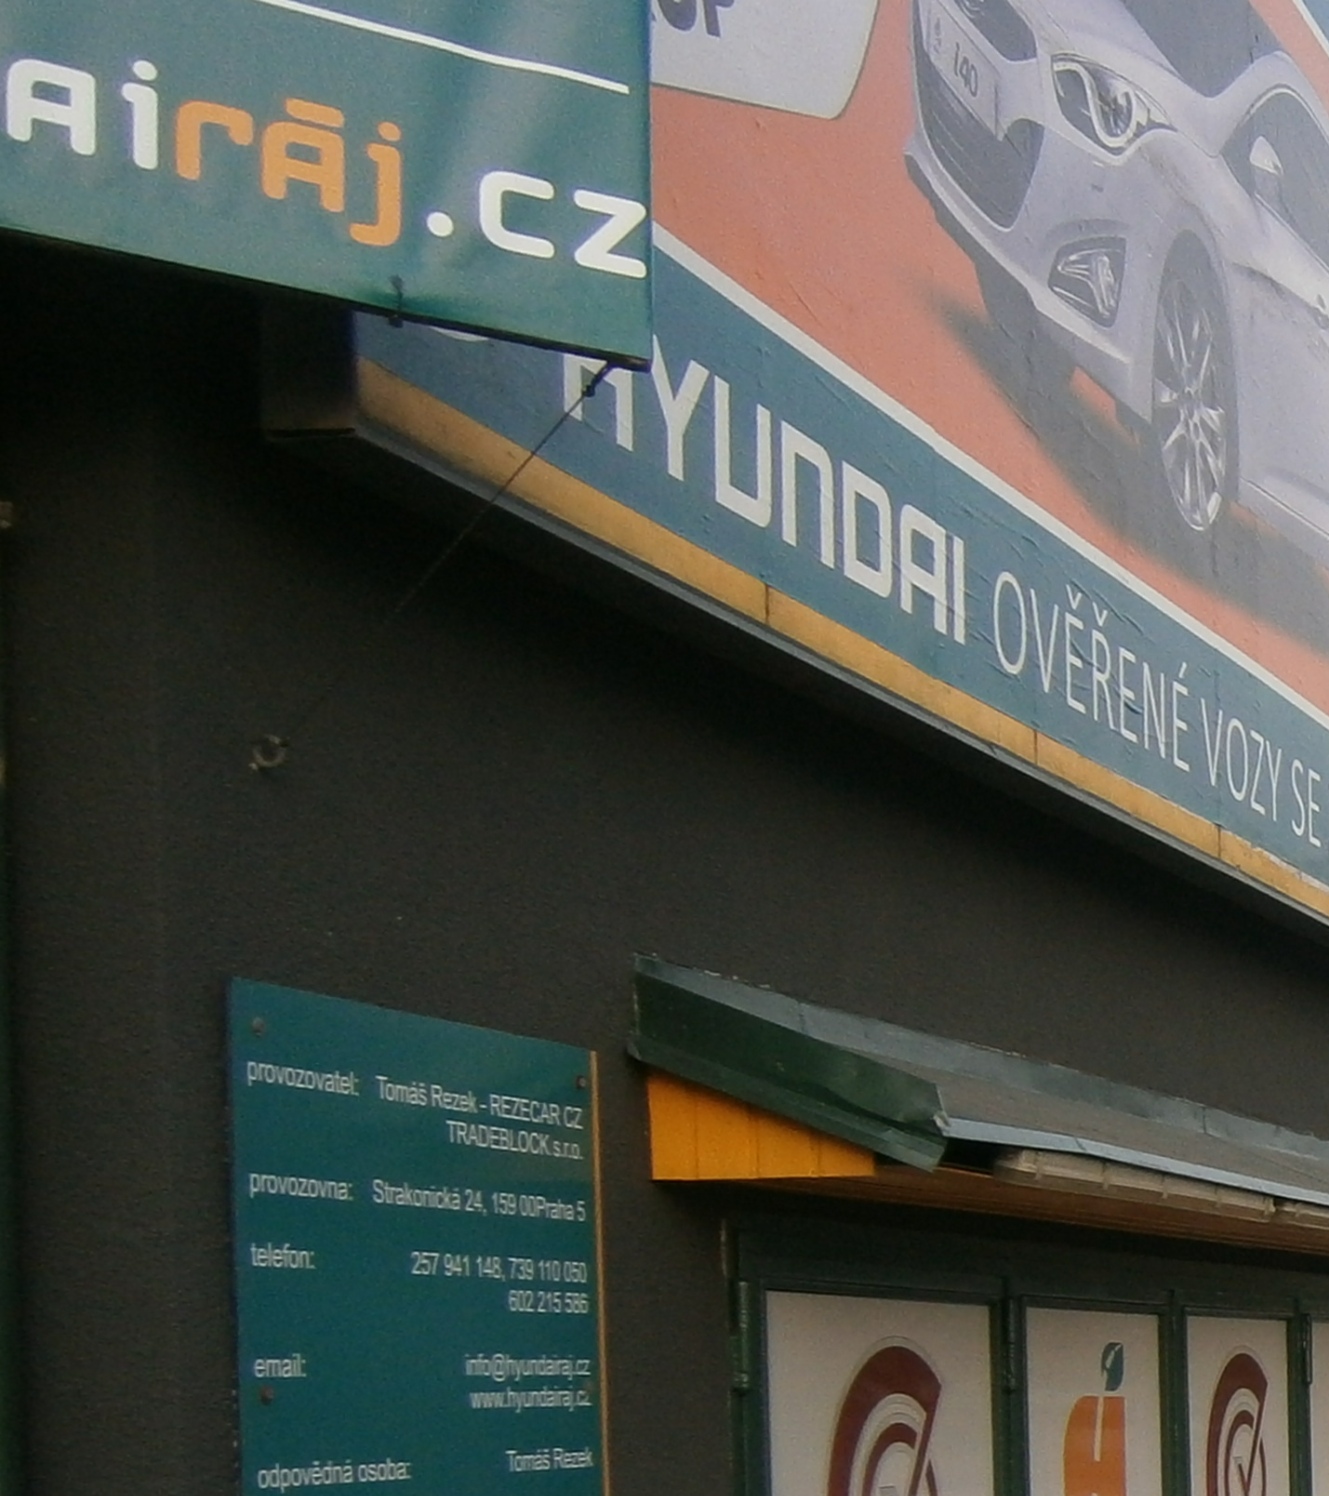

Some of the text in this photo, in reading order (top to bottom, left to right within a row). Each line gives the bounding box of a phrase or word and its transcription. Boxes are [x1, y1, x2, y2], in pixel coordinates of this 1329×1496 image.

[992, 570, 1190, 773] OVĚŘENÉ
[1200, 696, 1282, 823] VOZY
[1290, 759, 1321, 848] SE
[247, 1060, 360, 1096] provozovatel:
[375, 1075, 427, 1106] Tomáš
[431, 1084, 478, 1113] Rezek
[490, 1094, 561, 1126] REZECAR
[563, 1106, 584, 1129] CZ
[446, 1120, 551, 1154] TRADEBLOCK
[249, 1173, 354, 1201] provozovna:
[372, 1179, 461, 1211] Strakonická
[492, 1192, 517, 1215] 159
[577, 1200, 586, 1222] 5
[250, 1243, 315, 1270] telefon:
[410, 1251, 440, 1275] 257
[443, 1253, 470, 1277] 941
[507, 1257, 534, 1280] 739
[538, 1260, 561, 1282] 110
[537, 1291, 562, 1313] 215
[254, 1353, 306, 1379] email:
[257, 1460, 353, 1493] odpovědná
[358, 1458, 412, 1483] osoba:
[505, 1448, 551, 1473] Tomáš
